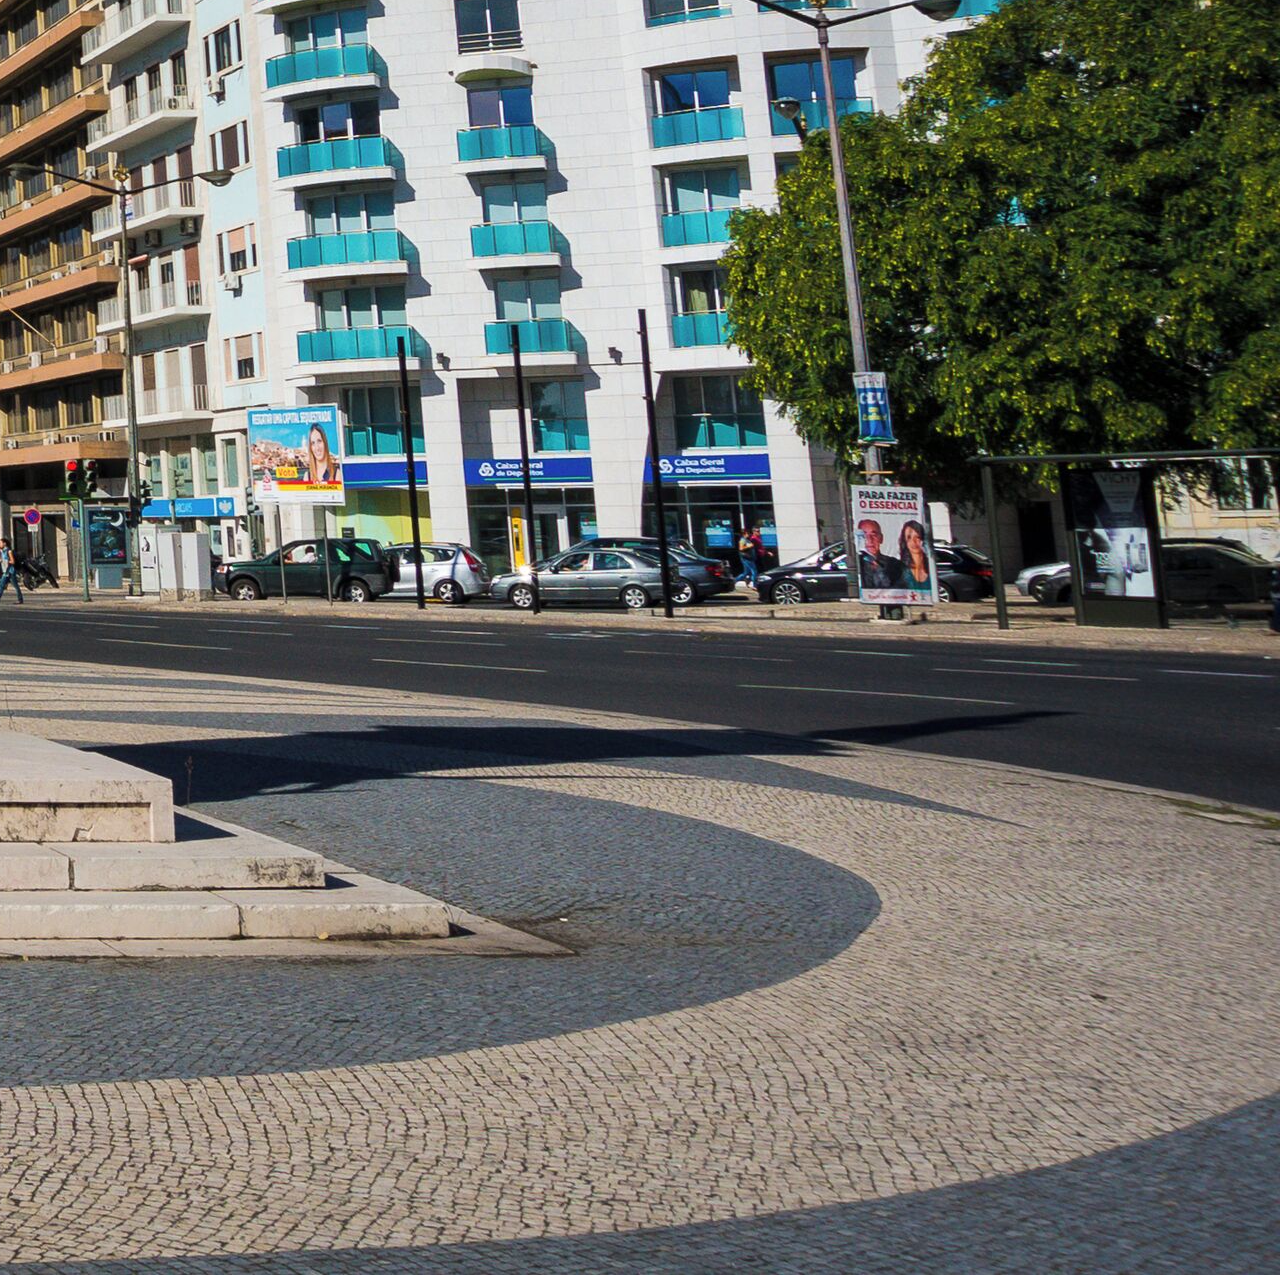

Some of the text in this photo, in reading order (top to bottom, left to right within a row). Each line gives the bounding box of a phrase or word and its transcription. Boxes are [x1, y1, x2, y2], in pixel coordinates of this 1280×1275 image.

[700, 458, 725, 466] Geral
[1099, 474, 1137, 483] VICHY
[858, 490, 918, 500] PARA FAZER
[859, 500, 918, 511] O ESSENCIAL
